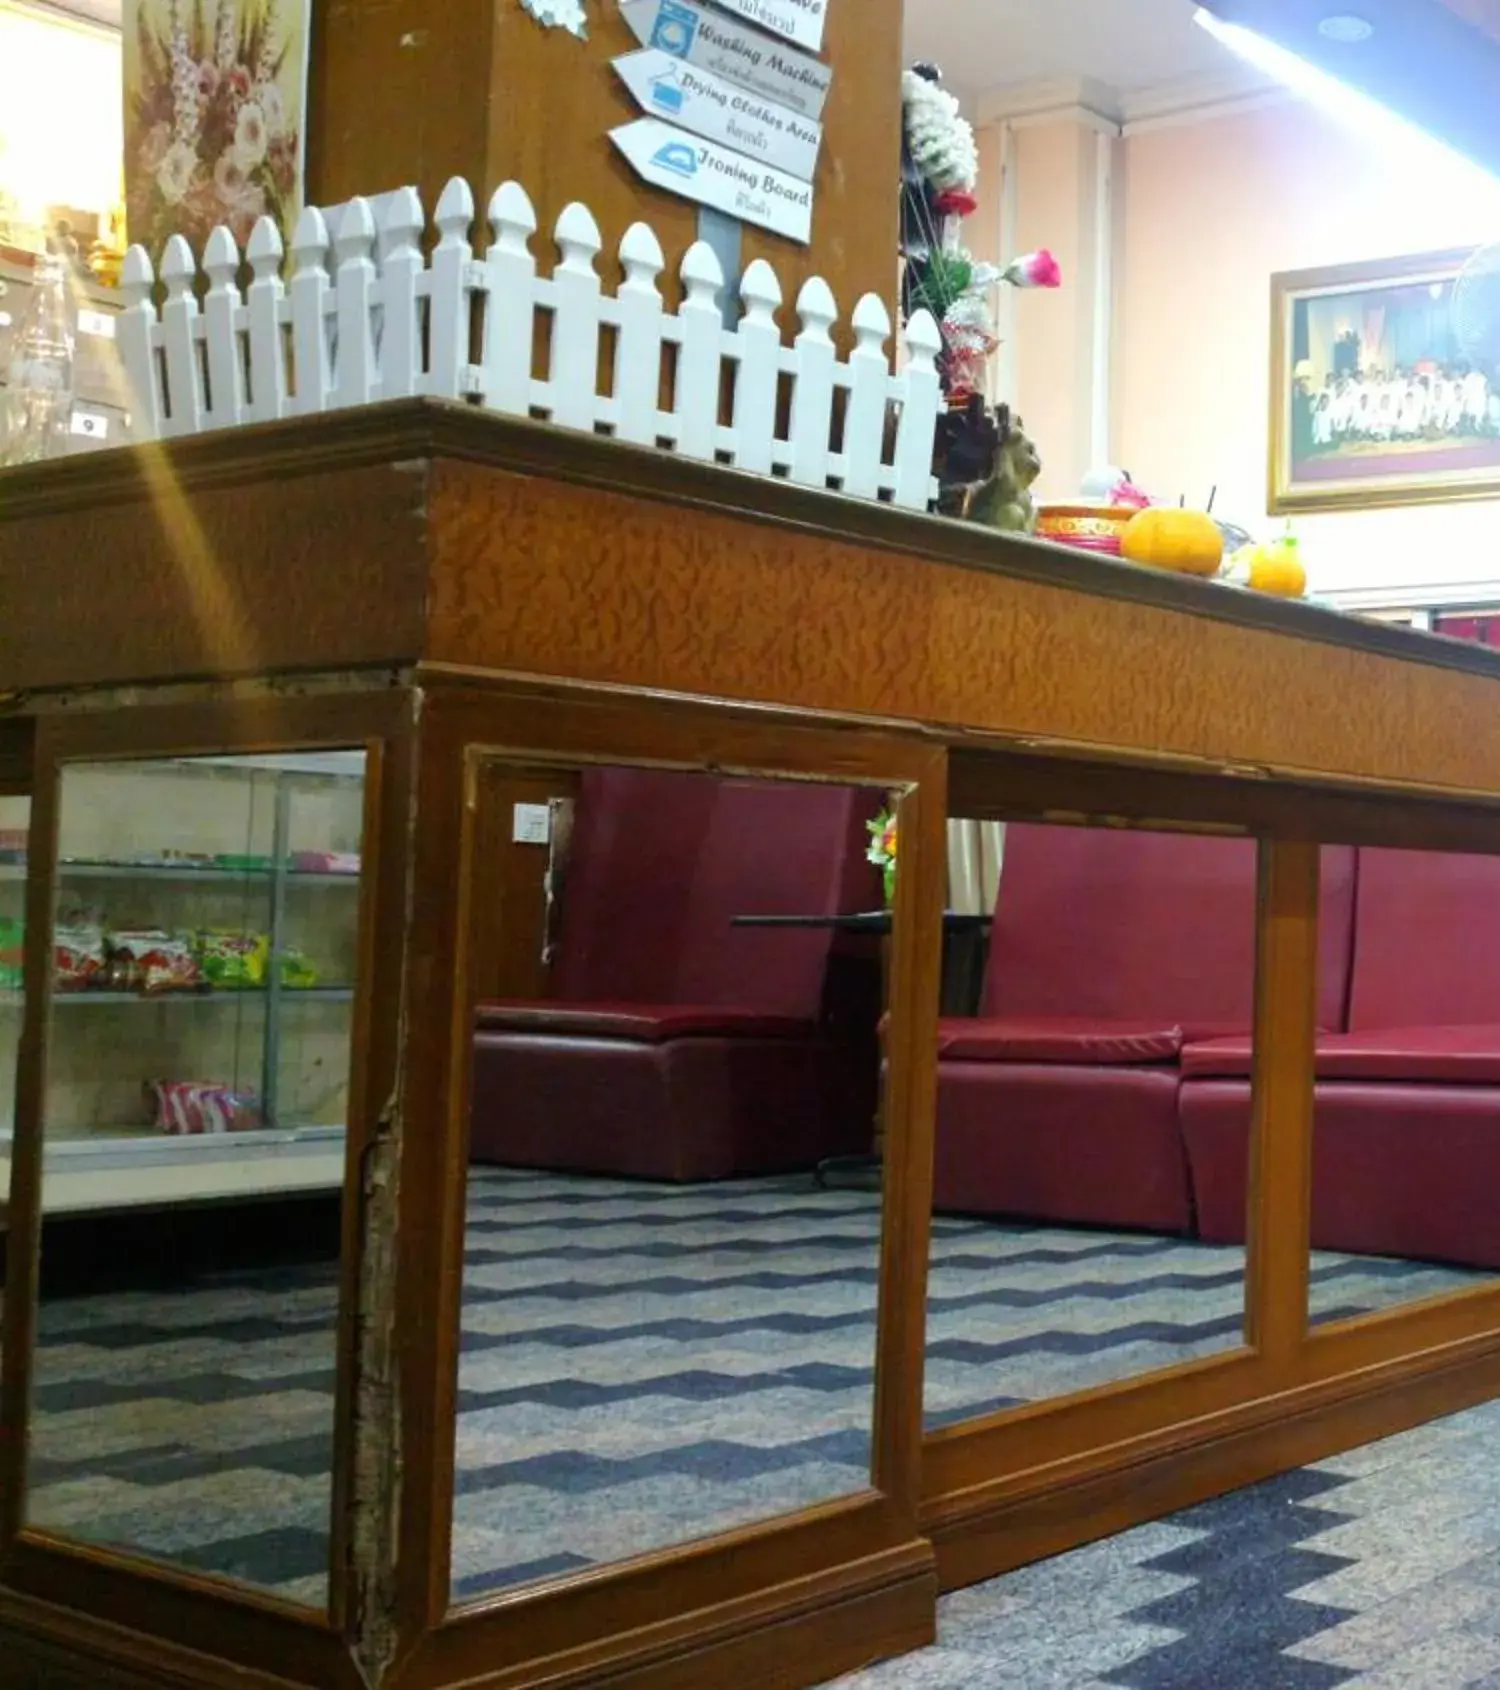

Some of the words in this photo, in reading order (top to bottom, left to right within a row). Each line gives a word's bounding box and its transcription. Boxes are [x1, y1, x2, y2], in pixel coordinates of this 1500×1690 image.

[699, 23, 762, 66] Washing
[765, 53, 827, 92] Machine
[680, 72, 727, 106] Drying
[730, 96, 783, 130] Clothes
[786, 121, 817, 145] Area
[697, 147, 758, 189] Ironing
[762, 174, 810, 207] Board
